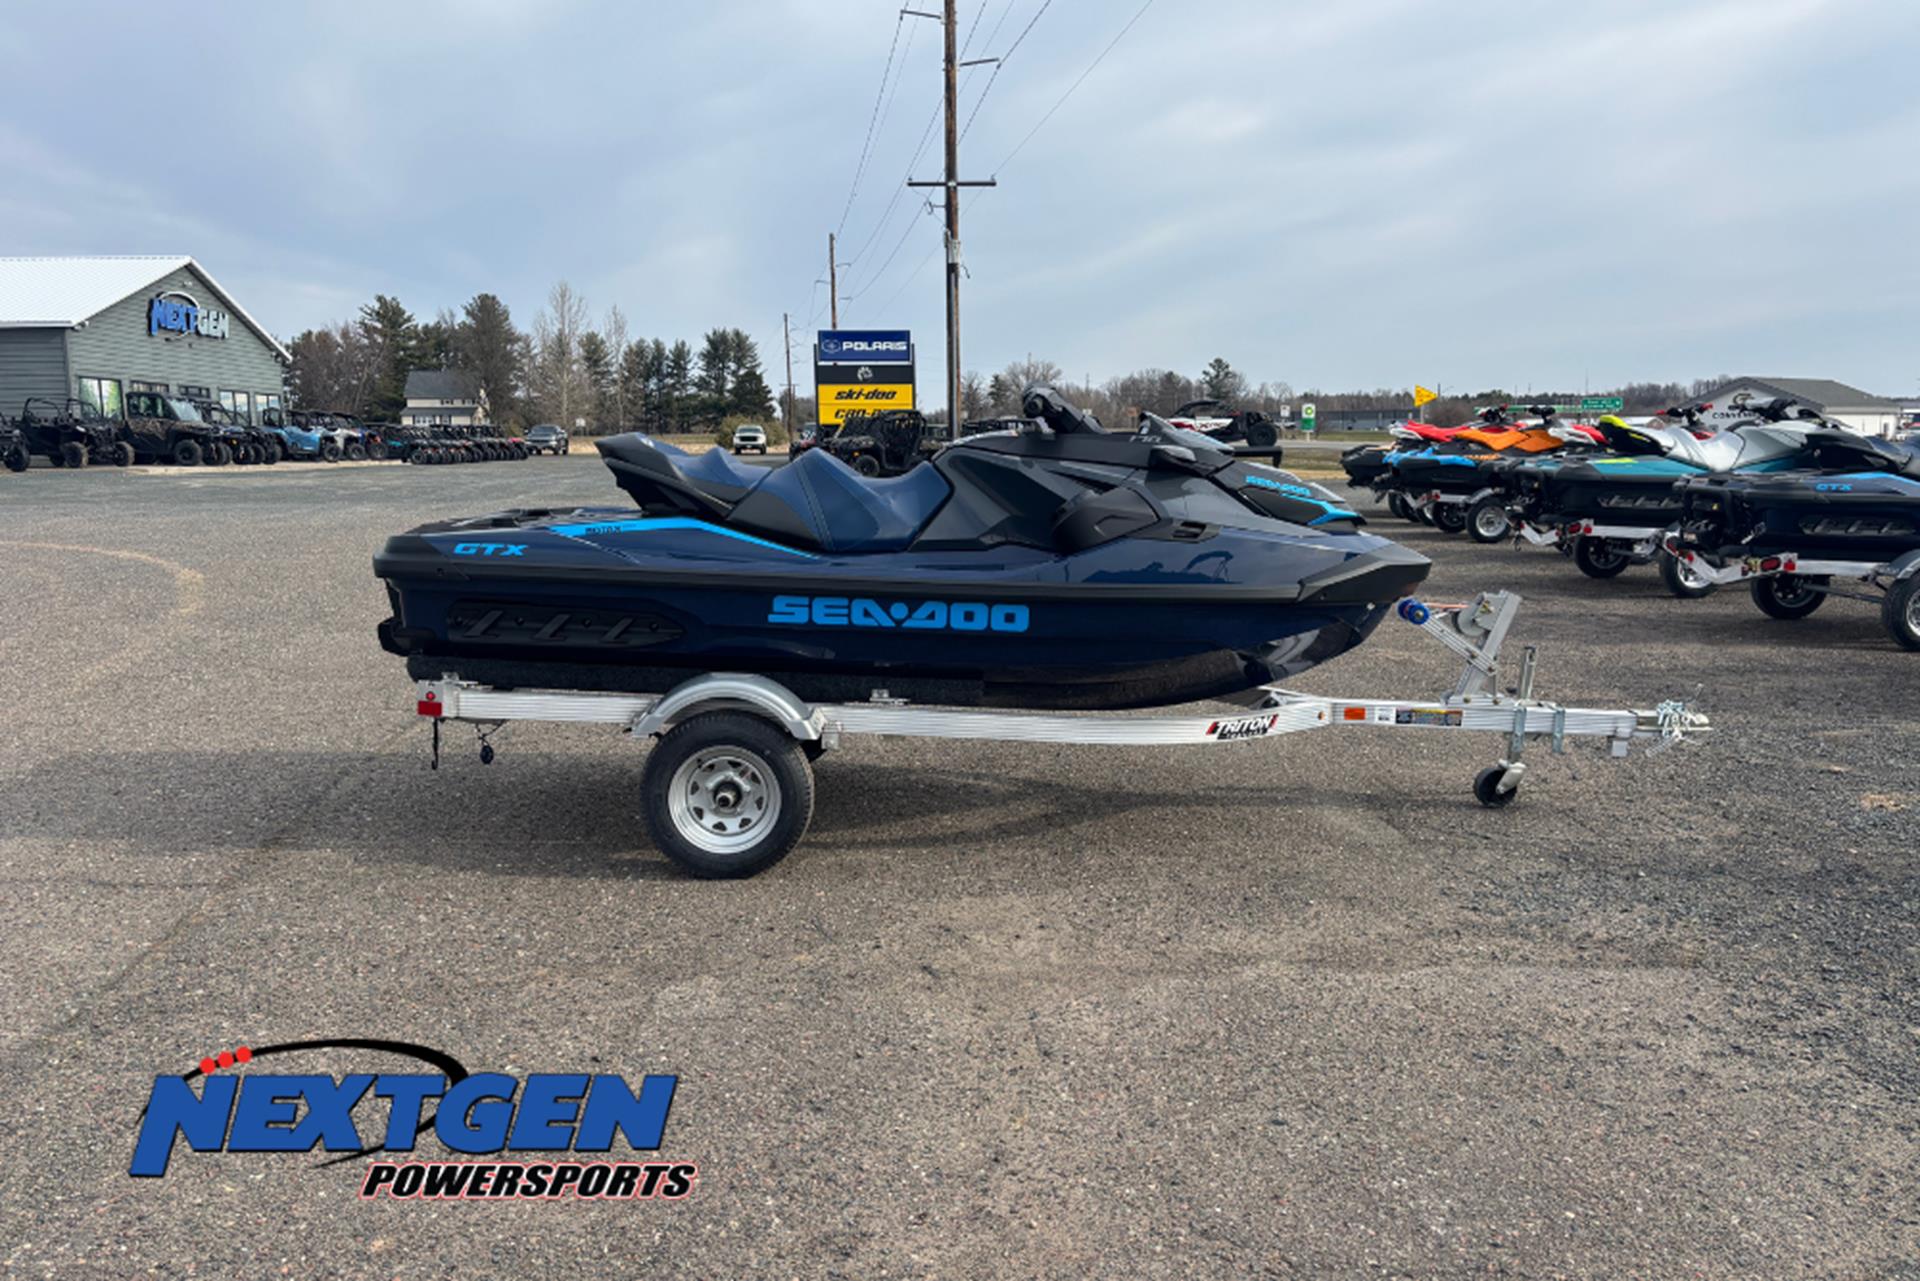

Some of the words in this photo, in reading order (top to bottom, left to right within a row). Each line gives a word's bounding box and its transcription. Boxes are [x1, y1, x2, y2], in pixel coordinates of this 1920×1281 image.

[151, 299, 229, 338] NEXTGEN
[842, 341, 907, 351] POLARIS
[1815, 483, 1853, 492] GTX
[453, 543, 529, 556] GTX
[1217, 713, 1276, 736] TRITON
